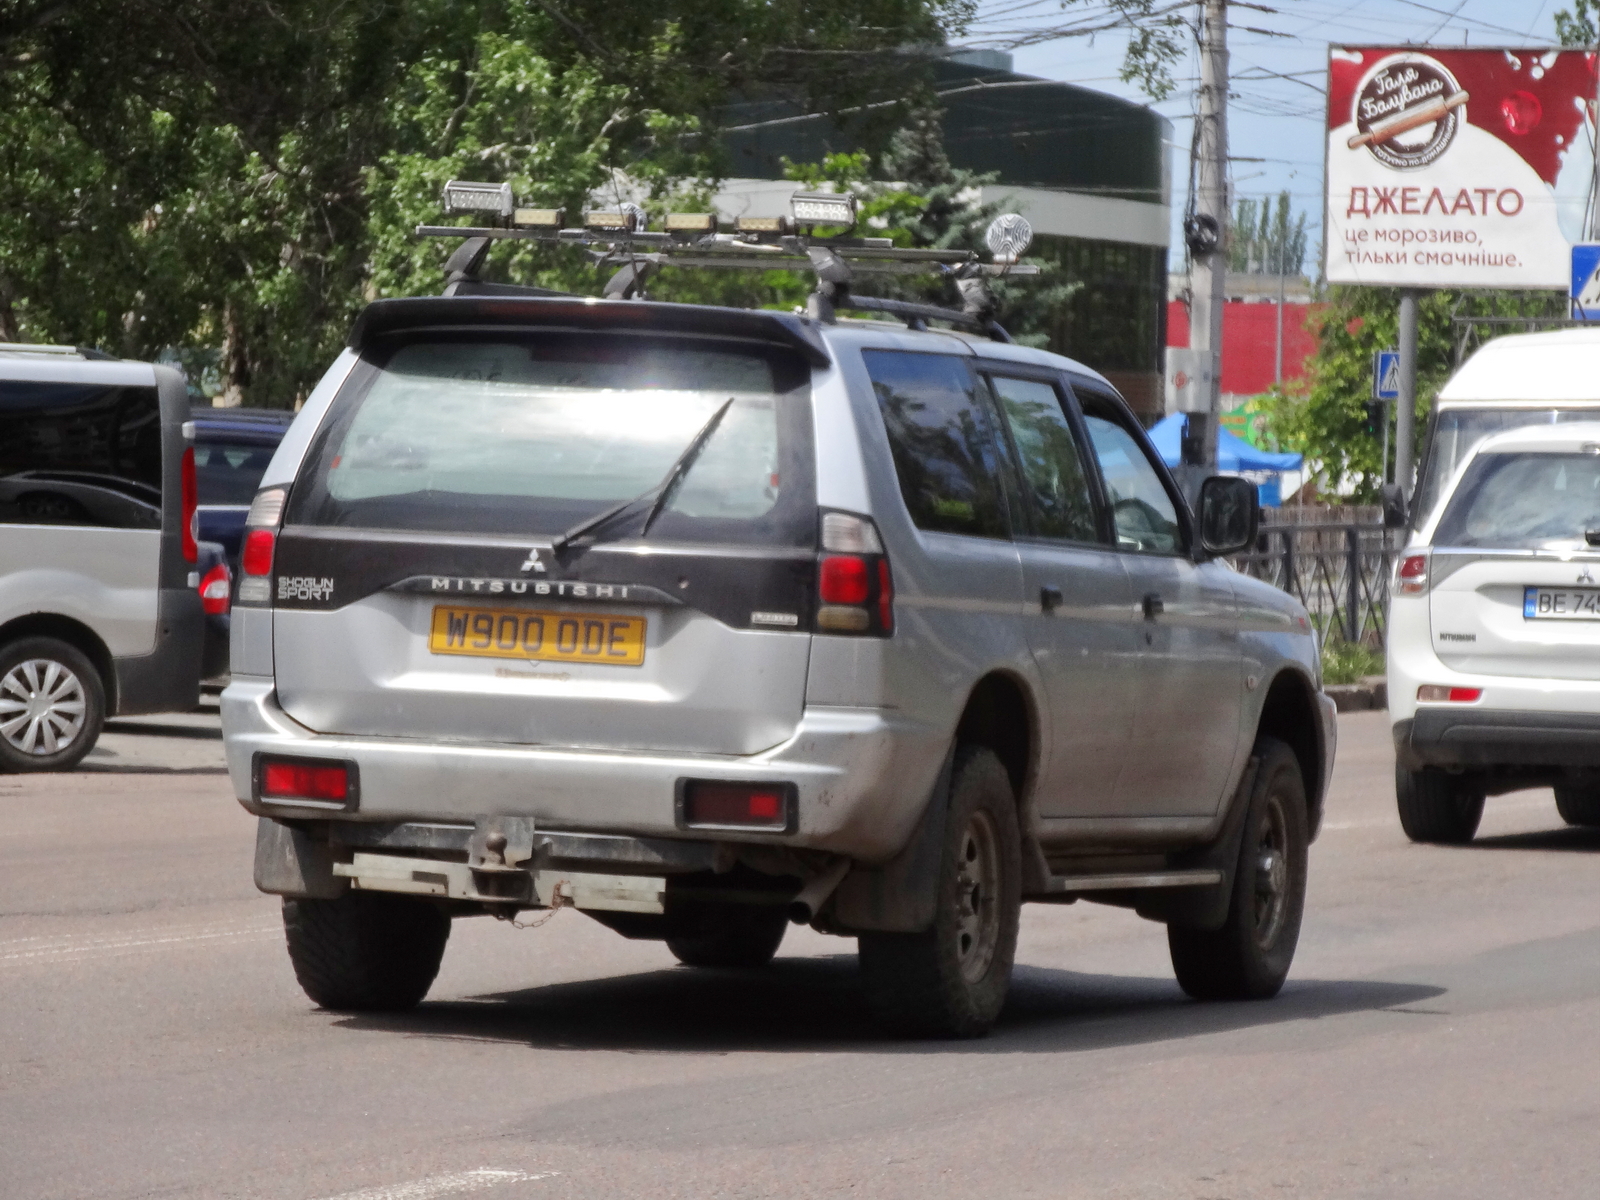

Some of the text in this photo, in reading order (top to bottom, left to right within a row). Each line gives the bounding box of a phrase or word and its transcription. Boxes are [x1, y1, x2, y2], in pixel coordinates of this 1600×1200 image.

[1375, 66, 1419, 95] Галя
[1362, 78, 1444, 118] Балувана
[1346, 186, 1525, 219] ДЖЕЛАТО
[1345, 228, 1484, 247] це морозиво,
[1345, 249, 1524, 268] тільки смачніше.
[278, 576, 334, 589] SHOGUN
[431, 577, 629, 599] MITSUBISHI
[277, 587, 334, 601] SPORT
[1539, 593, 1567, 614] BE
[445, 611, 632, 657] W900 ODE
